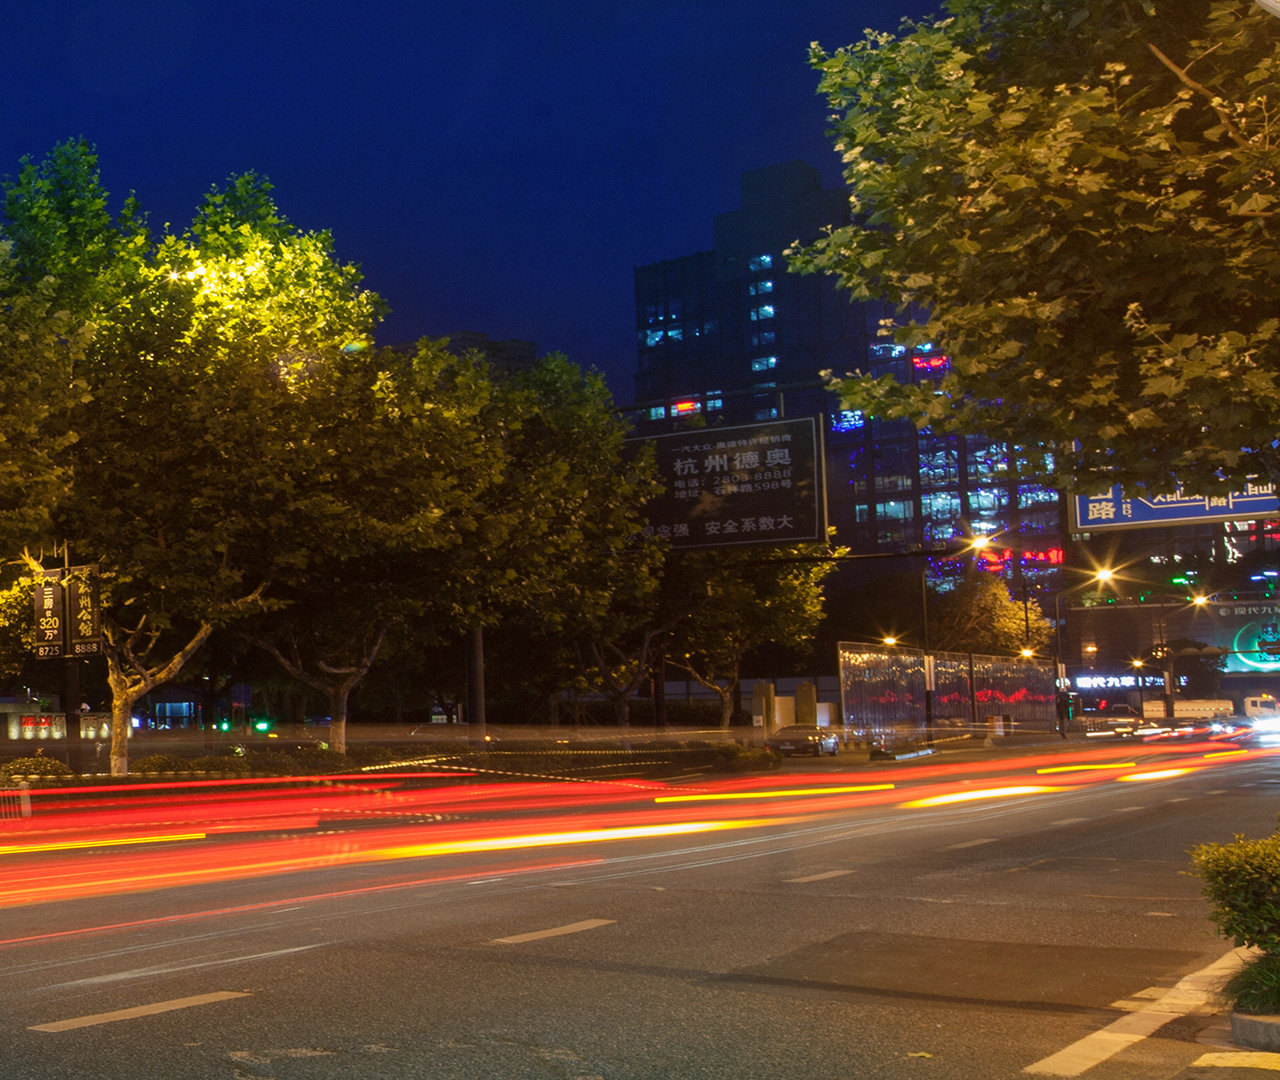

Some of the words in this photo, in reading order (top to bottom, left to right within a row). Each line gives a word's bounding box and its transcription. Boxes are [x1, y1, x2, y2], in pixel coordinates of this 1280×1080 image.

[673, 448, 792, 476] 杭州德奥
[704, 514, 794, 536] 安全系数大
[39, 616, 59, 629] 320
[38, 646, 60, 656] 8725
[75, 643, 98, 654] 8888
